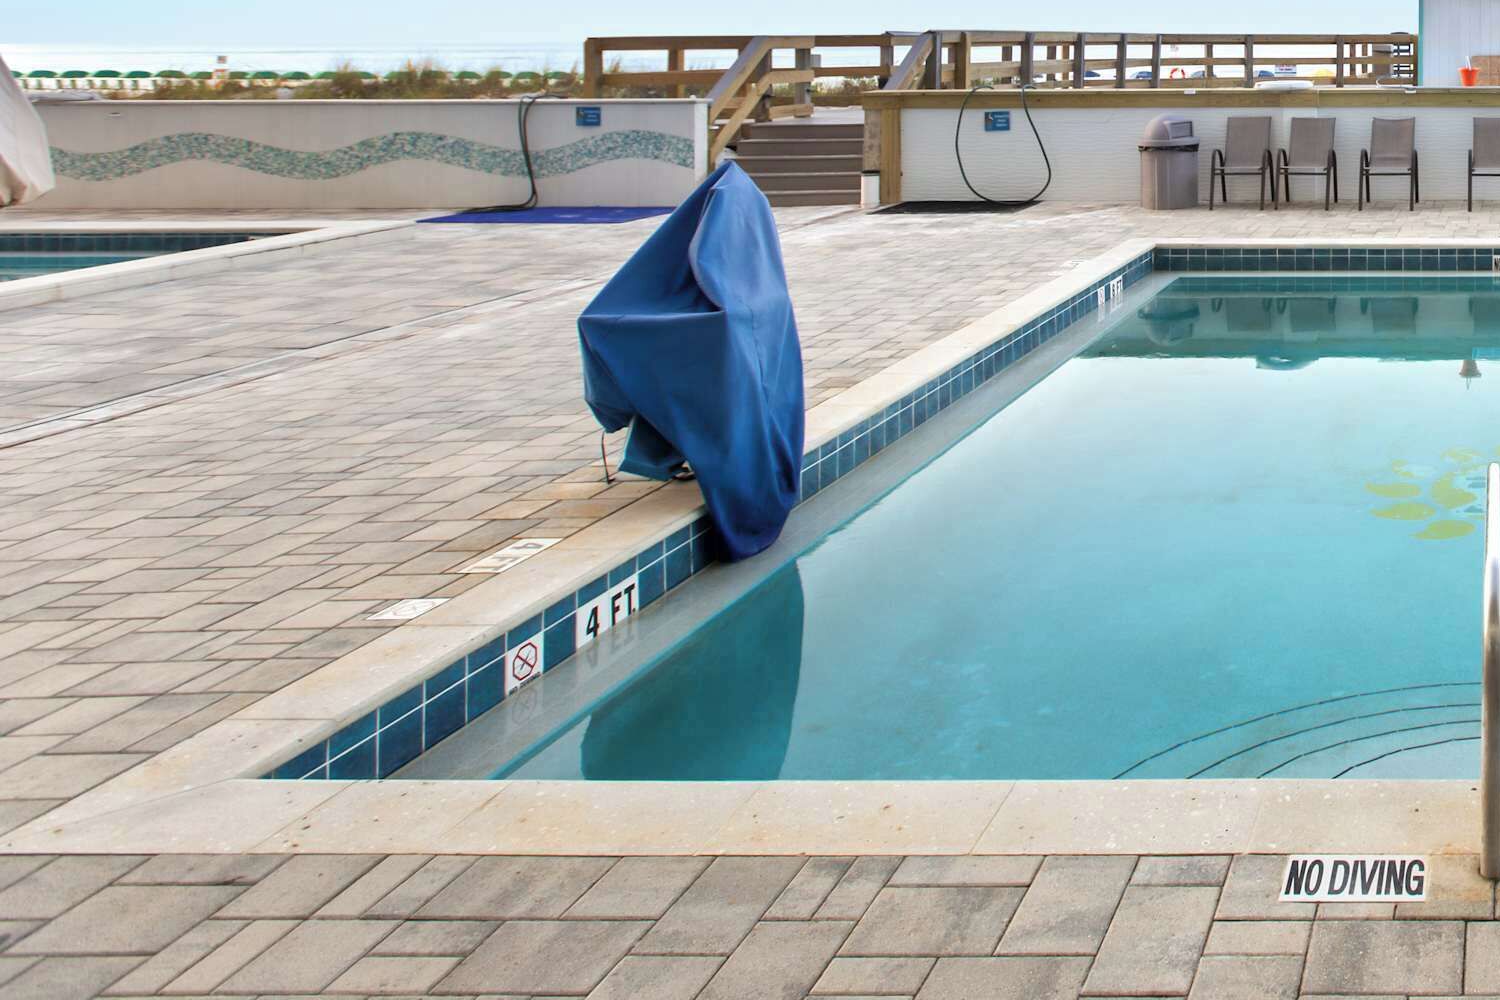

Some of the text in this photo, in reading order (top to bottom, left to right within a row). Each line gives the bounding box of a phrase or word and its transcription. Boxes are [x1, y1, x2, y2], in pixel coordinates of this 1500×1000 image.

[586, 583, 636, 638] 4 FT.
[1284, 859, 1425, 896] NO DIVING
